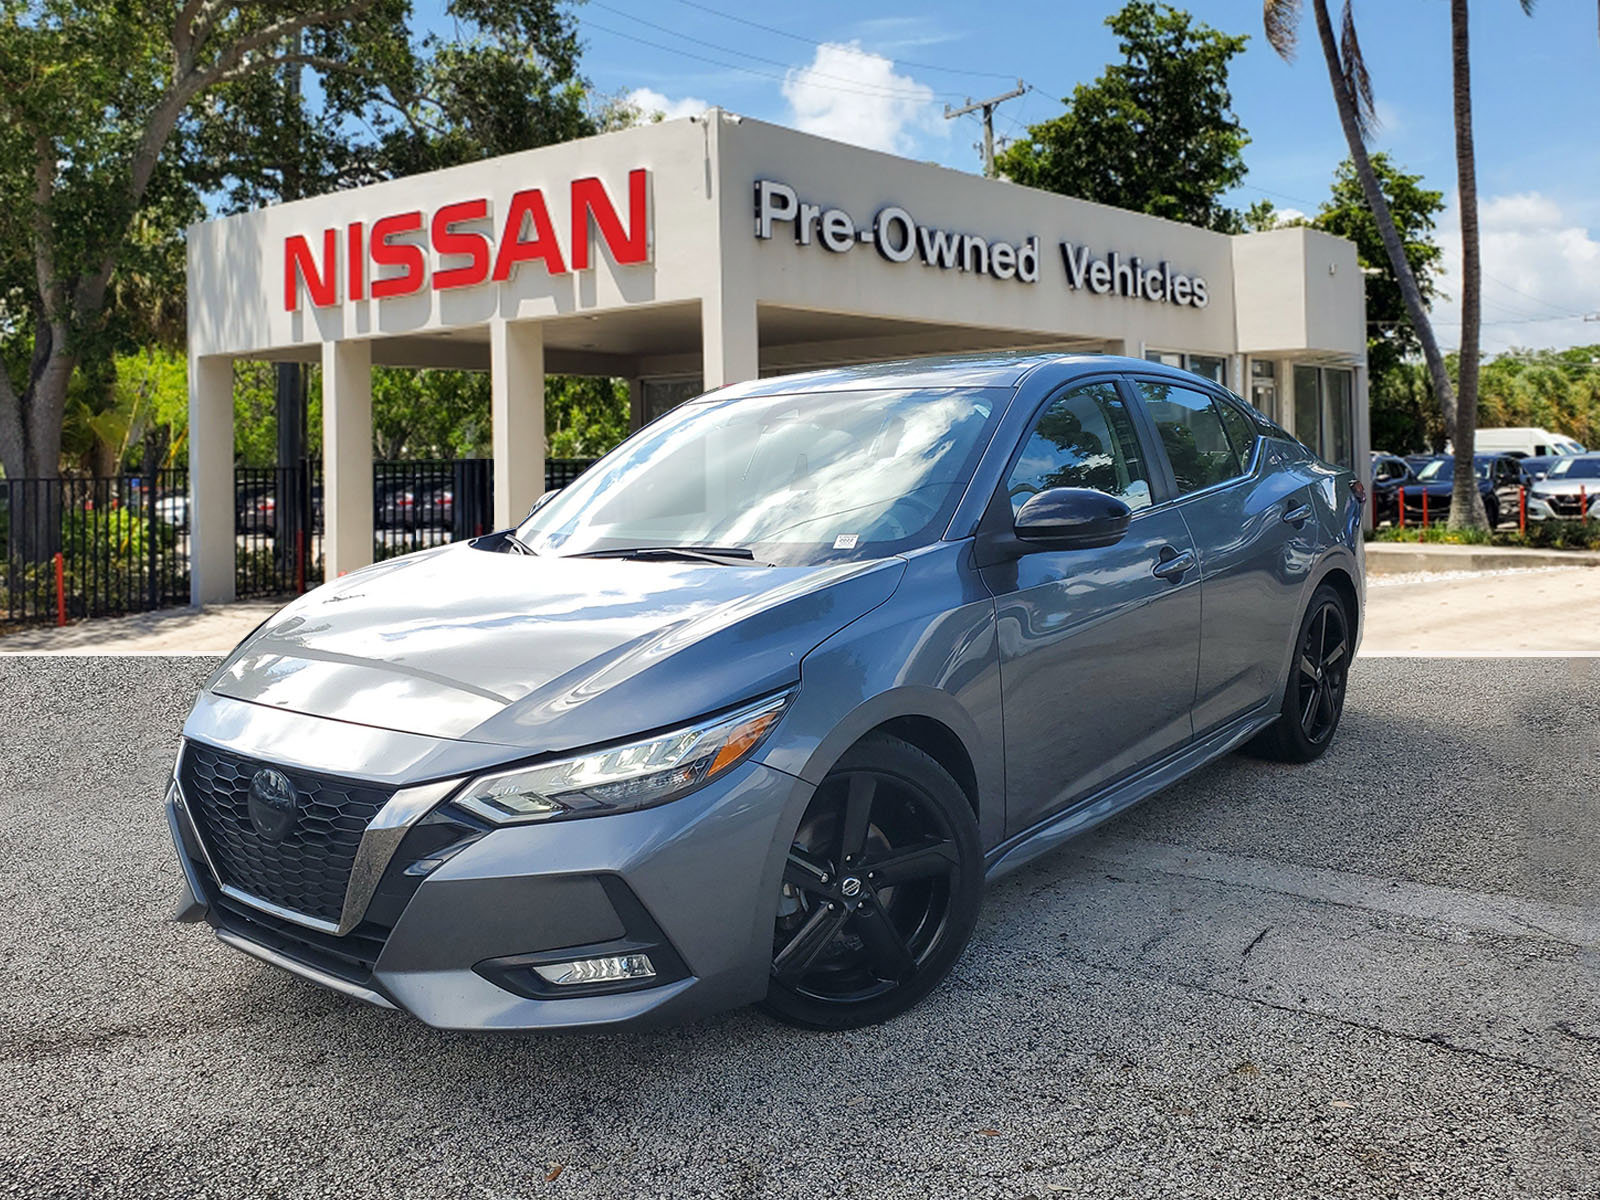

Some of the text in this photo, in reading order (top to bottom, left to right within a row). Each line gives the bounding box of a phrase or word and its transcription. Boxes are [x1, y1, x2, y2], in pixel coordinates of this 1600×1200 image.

[285, 168, 647, 312] NISSAN
[755, 179, 1209, 309] Pre-Owned Vehicles
